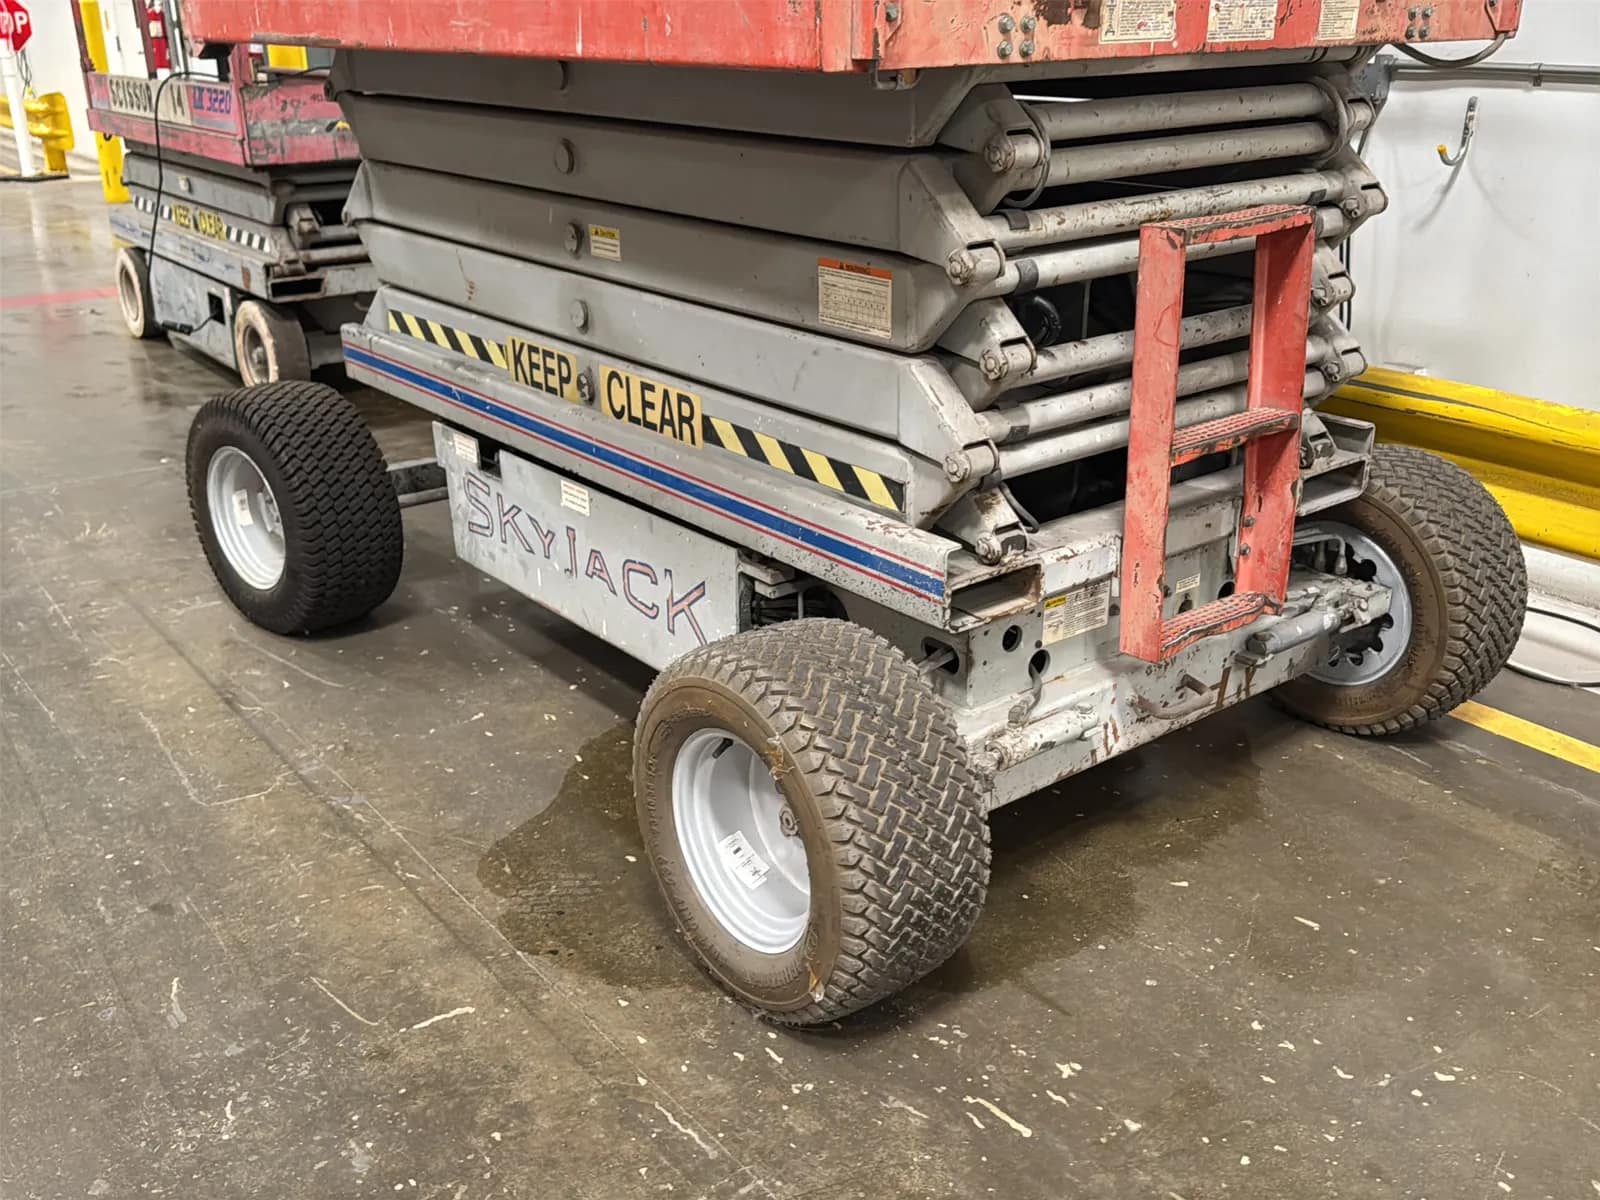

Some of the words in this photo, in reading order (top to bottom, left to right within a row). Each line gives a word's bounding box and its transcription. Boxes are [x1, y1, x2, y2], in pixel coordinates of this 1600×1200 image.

[206, 87, 232, 115] 3220
[511, 338, 572, 399] KEEP
[606, 370, 697, 446] CLEAR
[462, 471, 710, 647] SKYJACK
